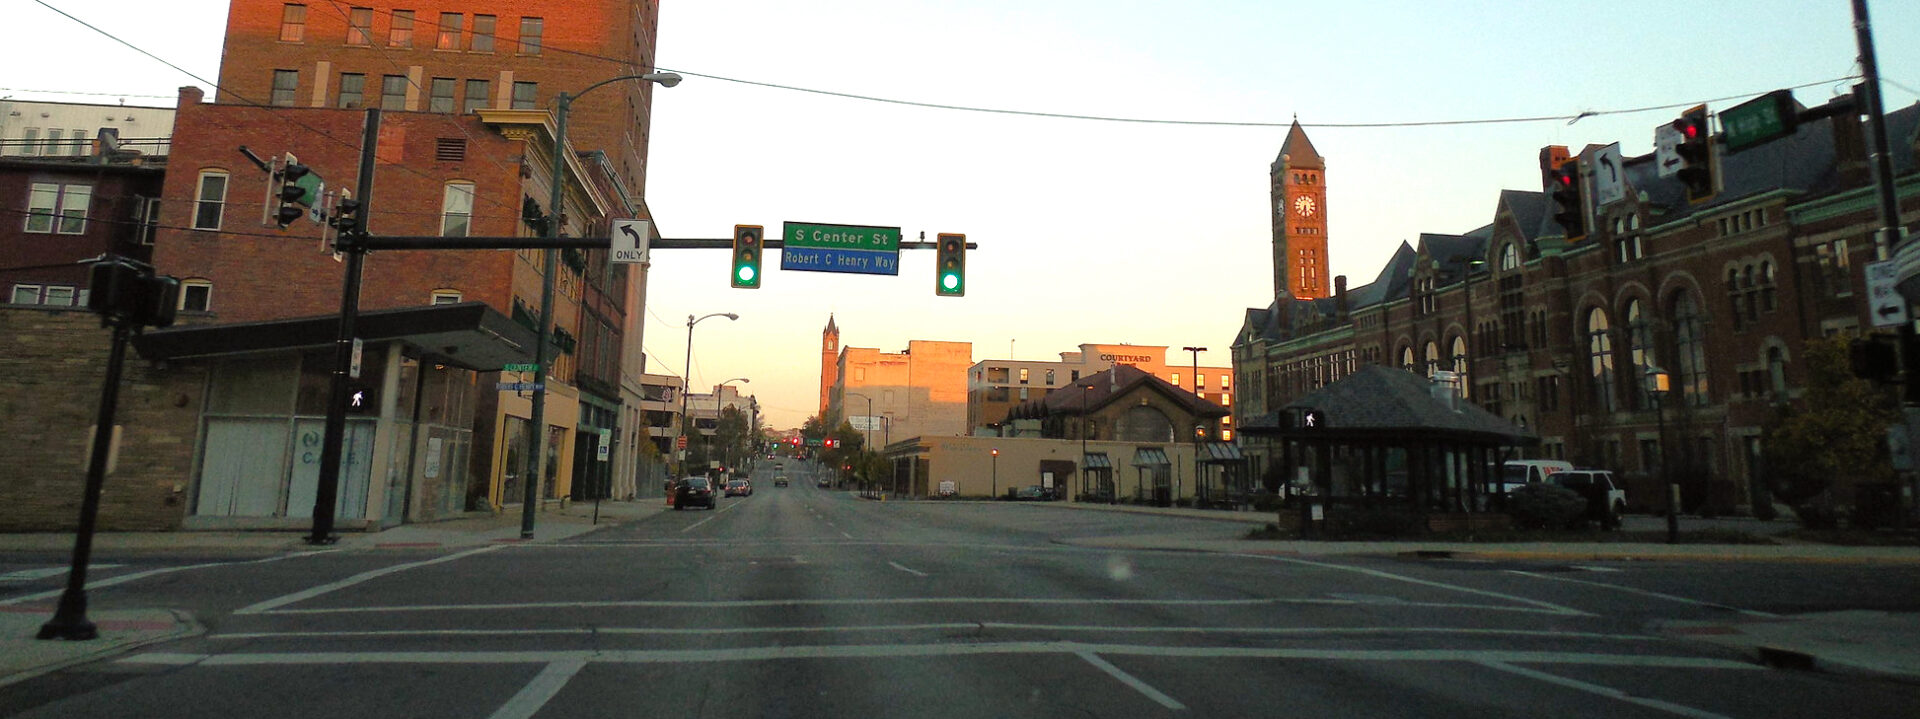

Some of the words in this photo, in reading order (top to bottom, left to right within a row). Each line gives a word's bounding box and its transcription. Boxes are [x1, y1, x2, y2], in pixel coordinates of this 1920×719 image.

[795, 229, 804, 240] S
[813, 230, 863, 244] Center
[872, 233, 889, 245] St
[616, 250, 643, 260] ONLY
[785, 251, 819, 265] Robert
[825, 253, 832, 265] C
[838, 254, 869, 269] Henry
[875, 255, 895, 270] Way
[1101, 354, 1151, 363] COURTYARD
